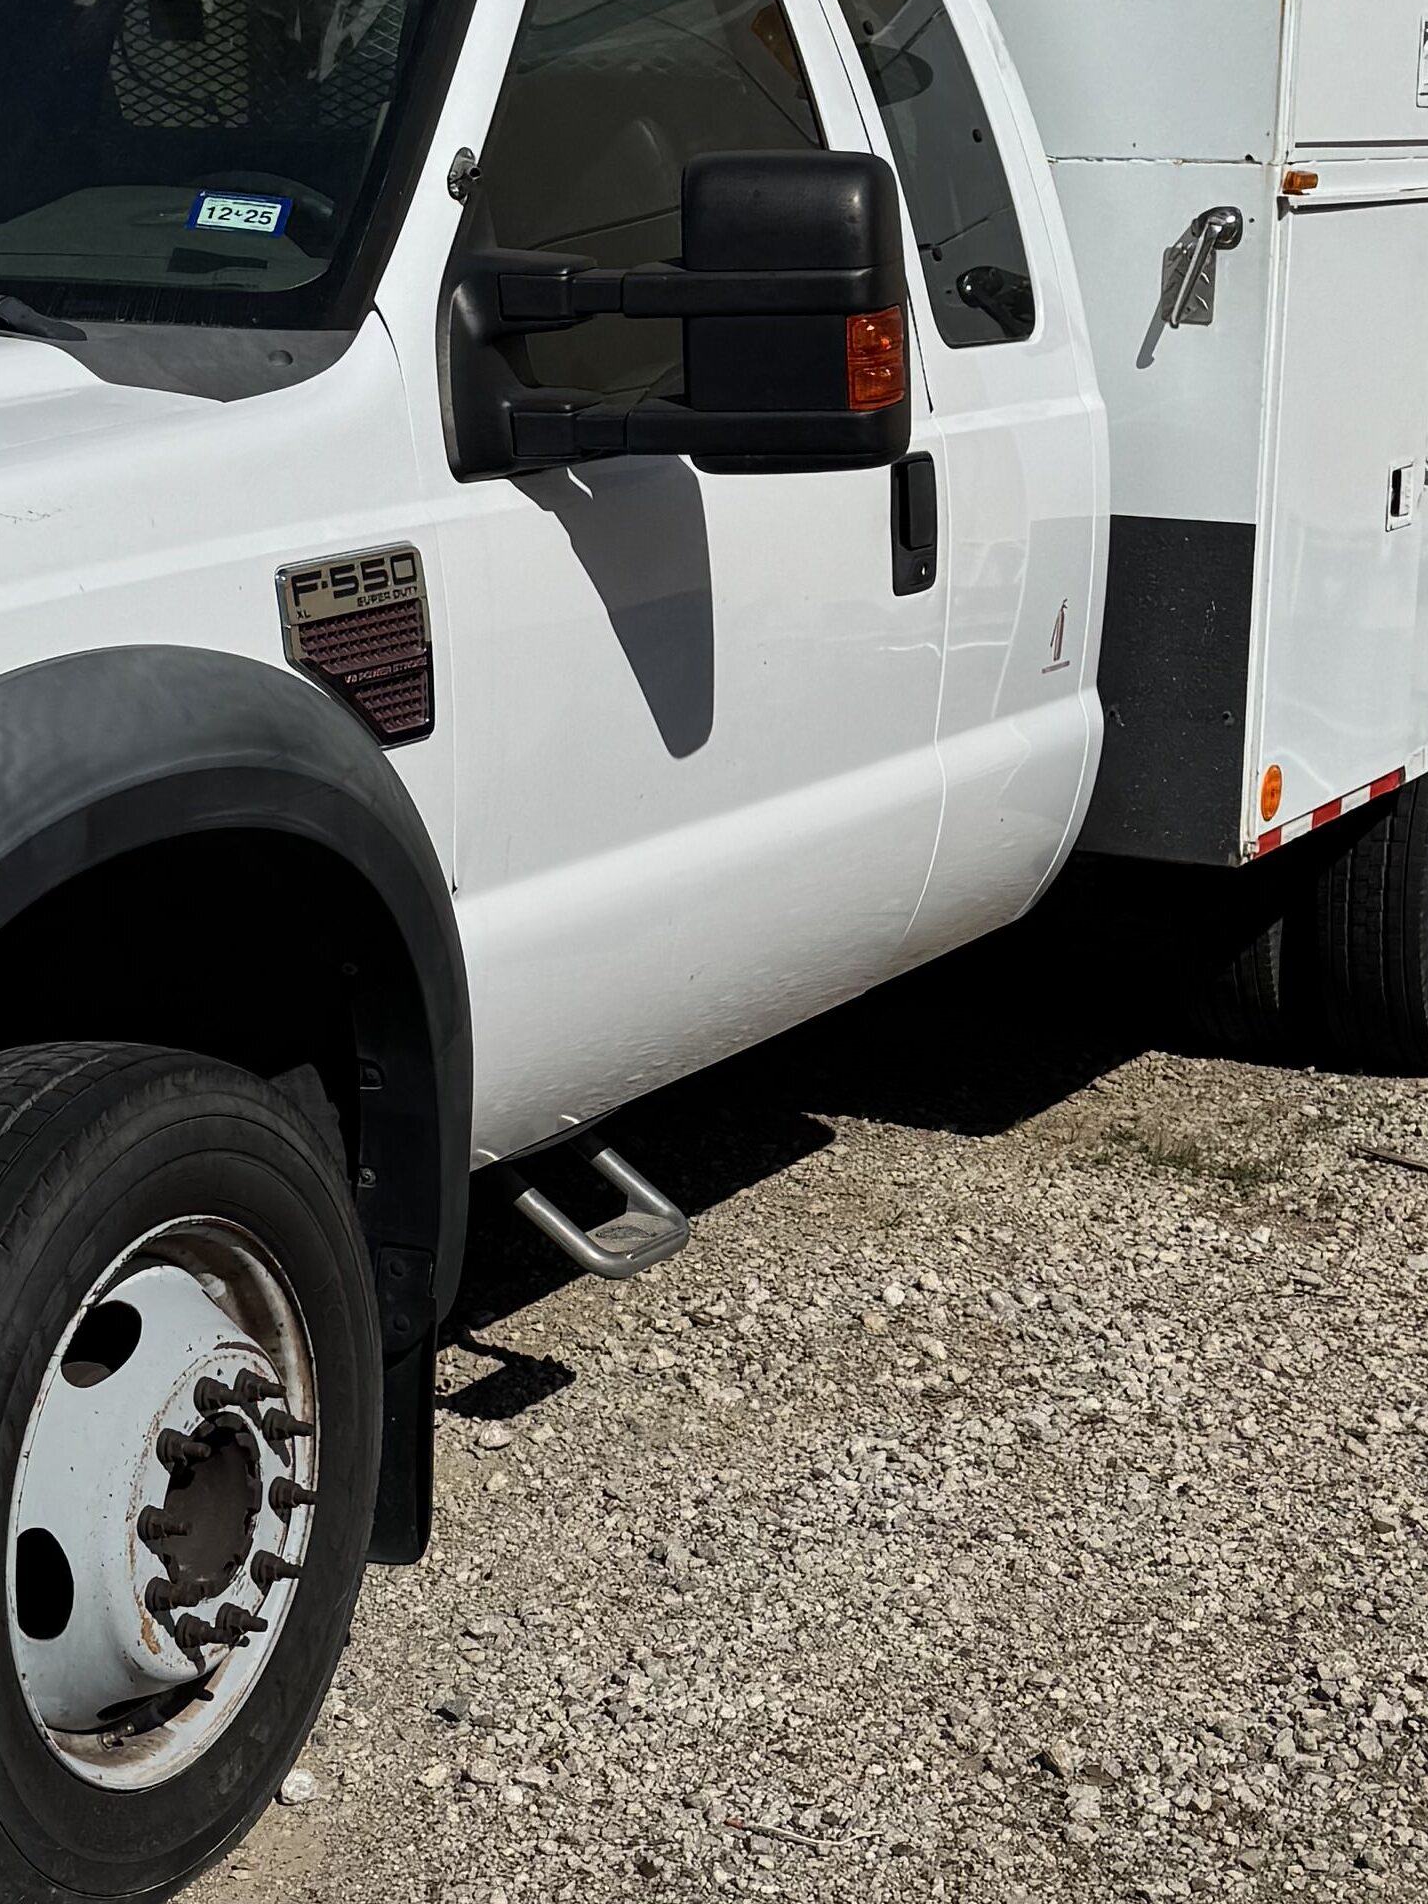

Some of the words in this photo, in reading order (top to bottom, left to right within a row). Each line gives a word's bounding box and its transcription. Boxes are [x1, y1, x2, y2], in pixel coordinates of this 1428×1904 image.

[356, 591, 391, 607] SUPER
[393, 586, 419, 599] DUTY
[296, 607, 312, 620] XL
